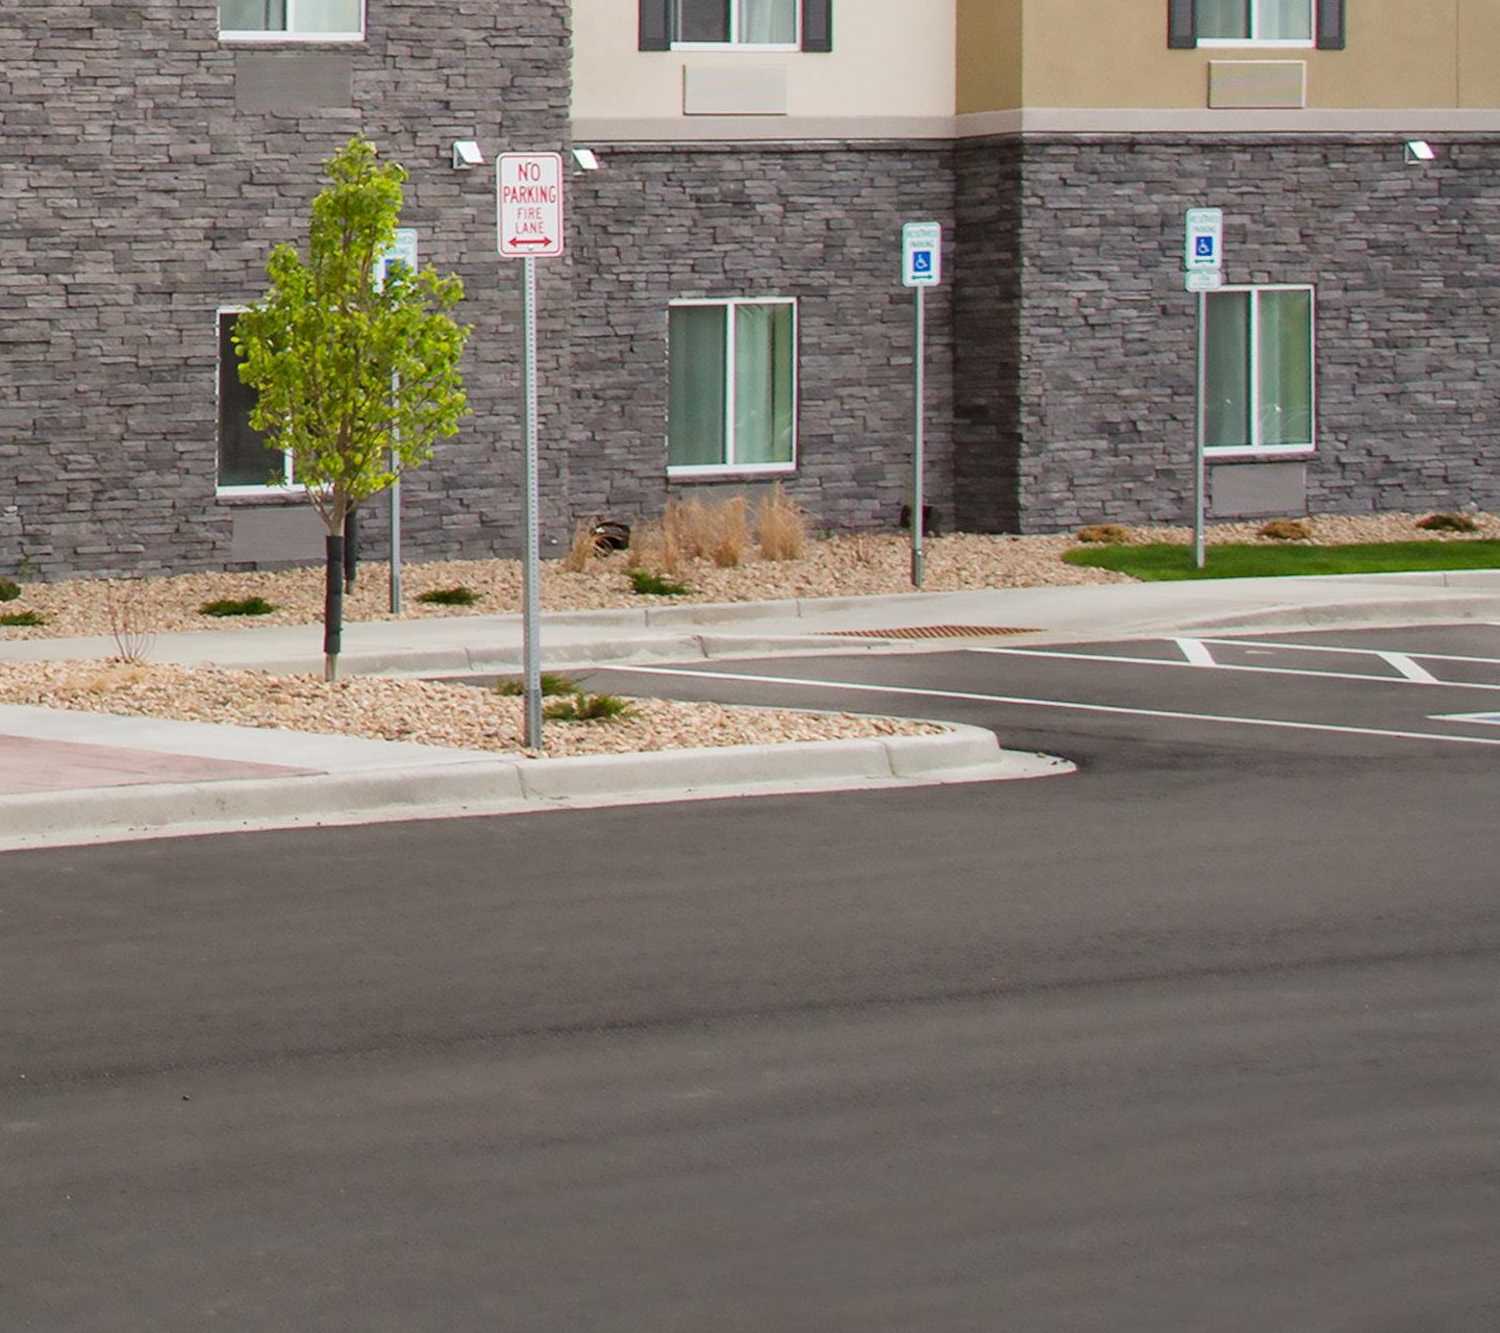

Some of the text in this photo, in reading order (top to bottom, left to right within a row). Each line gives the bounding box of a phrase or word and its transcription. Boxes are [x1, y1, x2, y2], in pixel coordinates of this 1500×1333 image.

[517, 162, 541, 182] NO
[503, 186, 557, 204] PARKING
[517, 207, 542, 220] FIRE
[515, 221, 545, 234] LANE
